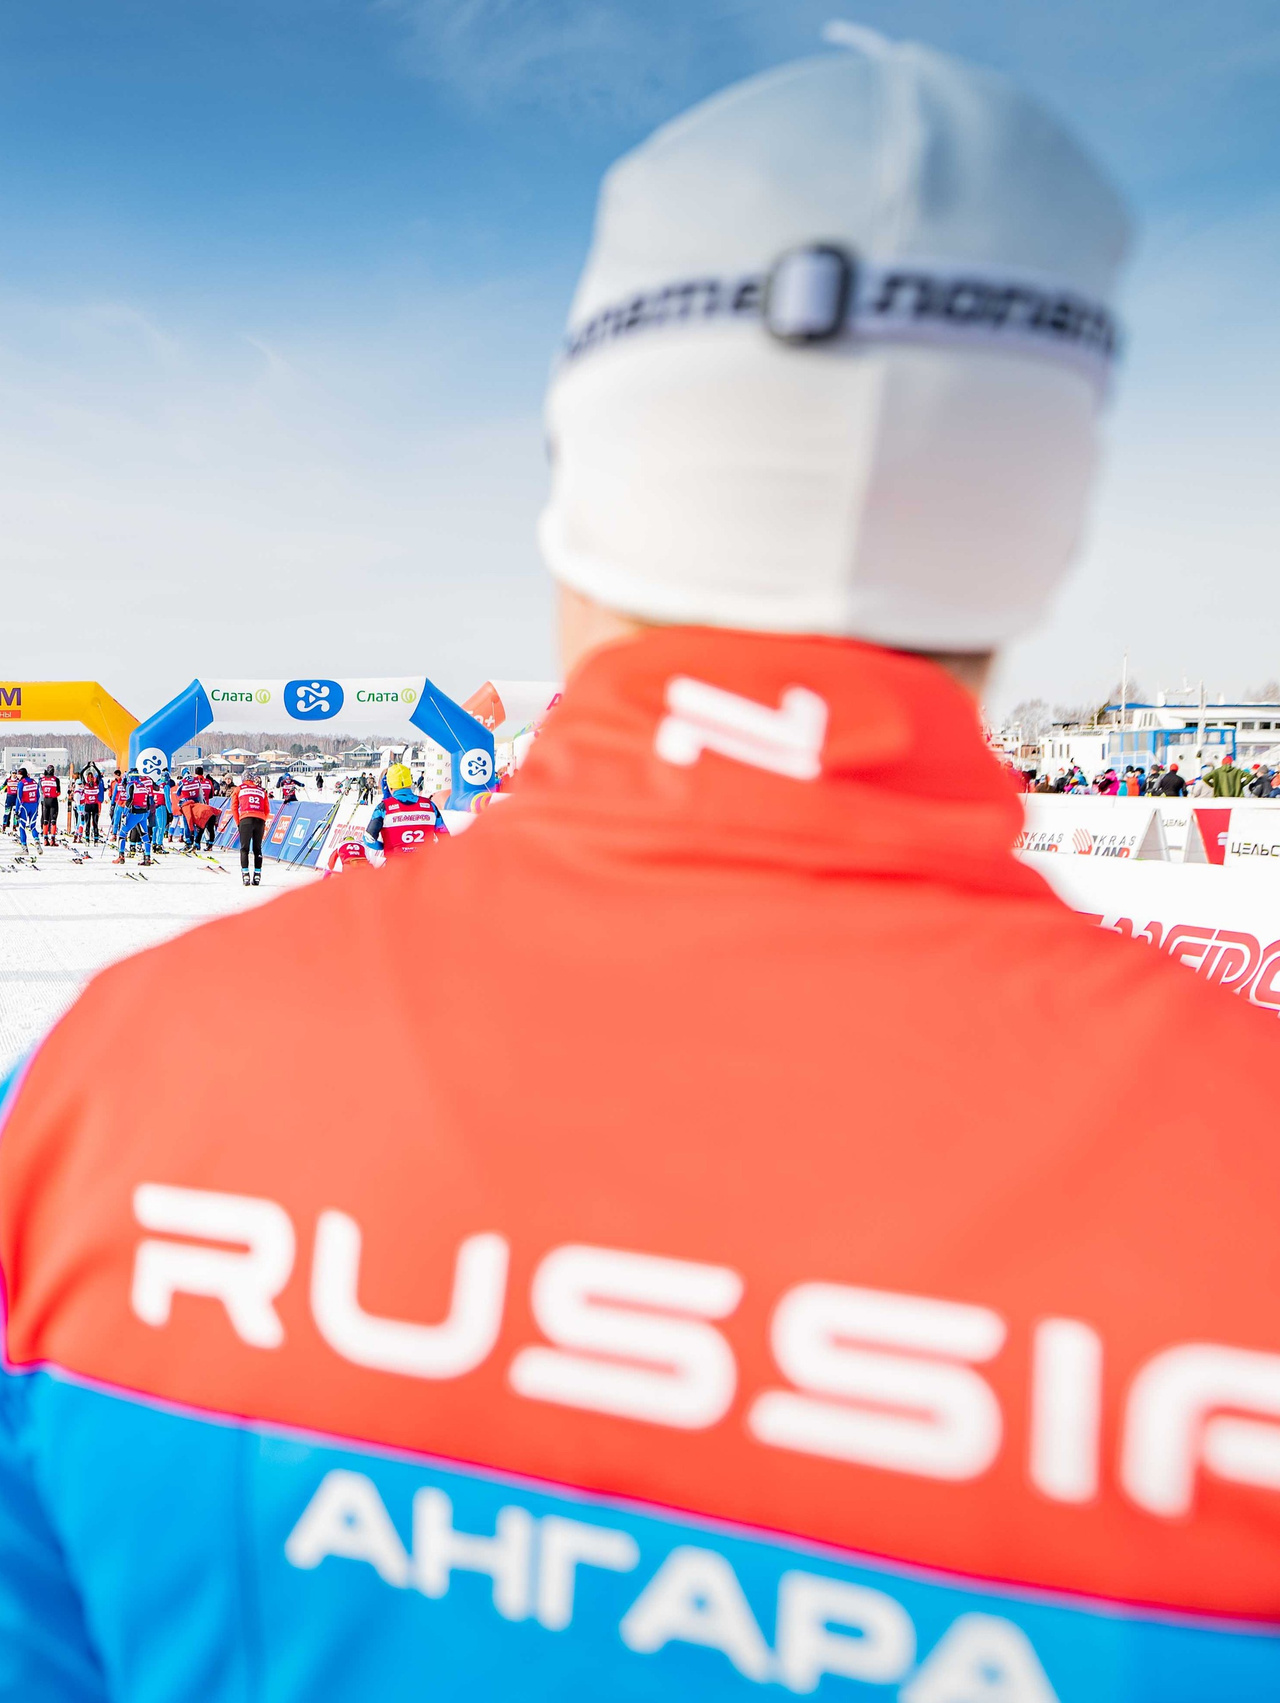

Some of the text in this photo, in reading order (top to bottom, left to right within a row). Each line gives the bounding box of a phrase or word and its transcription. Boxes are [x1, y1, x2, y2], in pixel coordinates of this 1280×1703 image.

[211, 689, 253, 702] Слата
[356, 690, 399, 703] Слата
[248, 796, 260, 805] 82
[401, 829, 425, 844] 62
[1029, 832, 1064, 844] KRAS
[1099, 835, 1137, 847] KRAS
[283, 1467, 1063, 1703] АНГАРА
